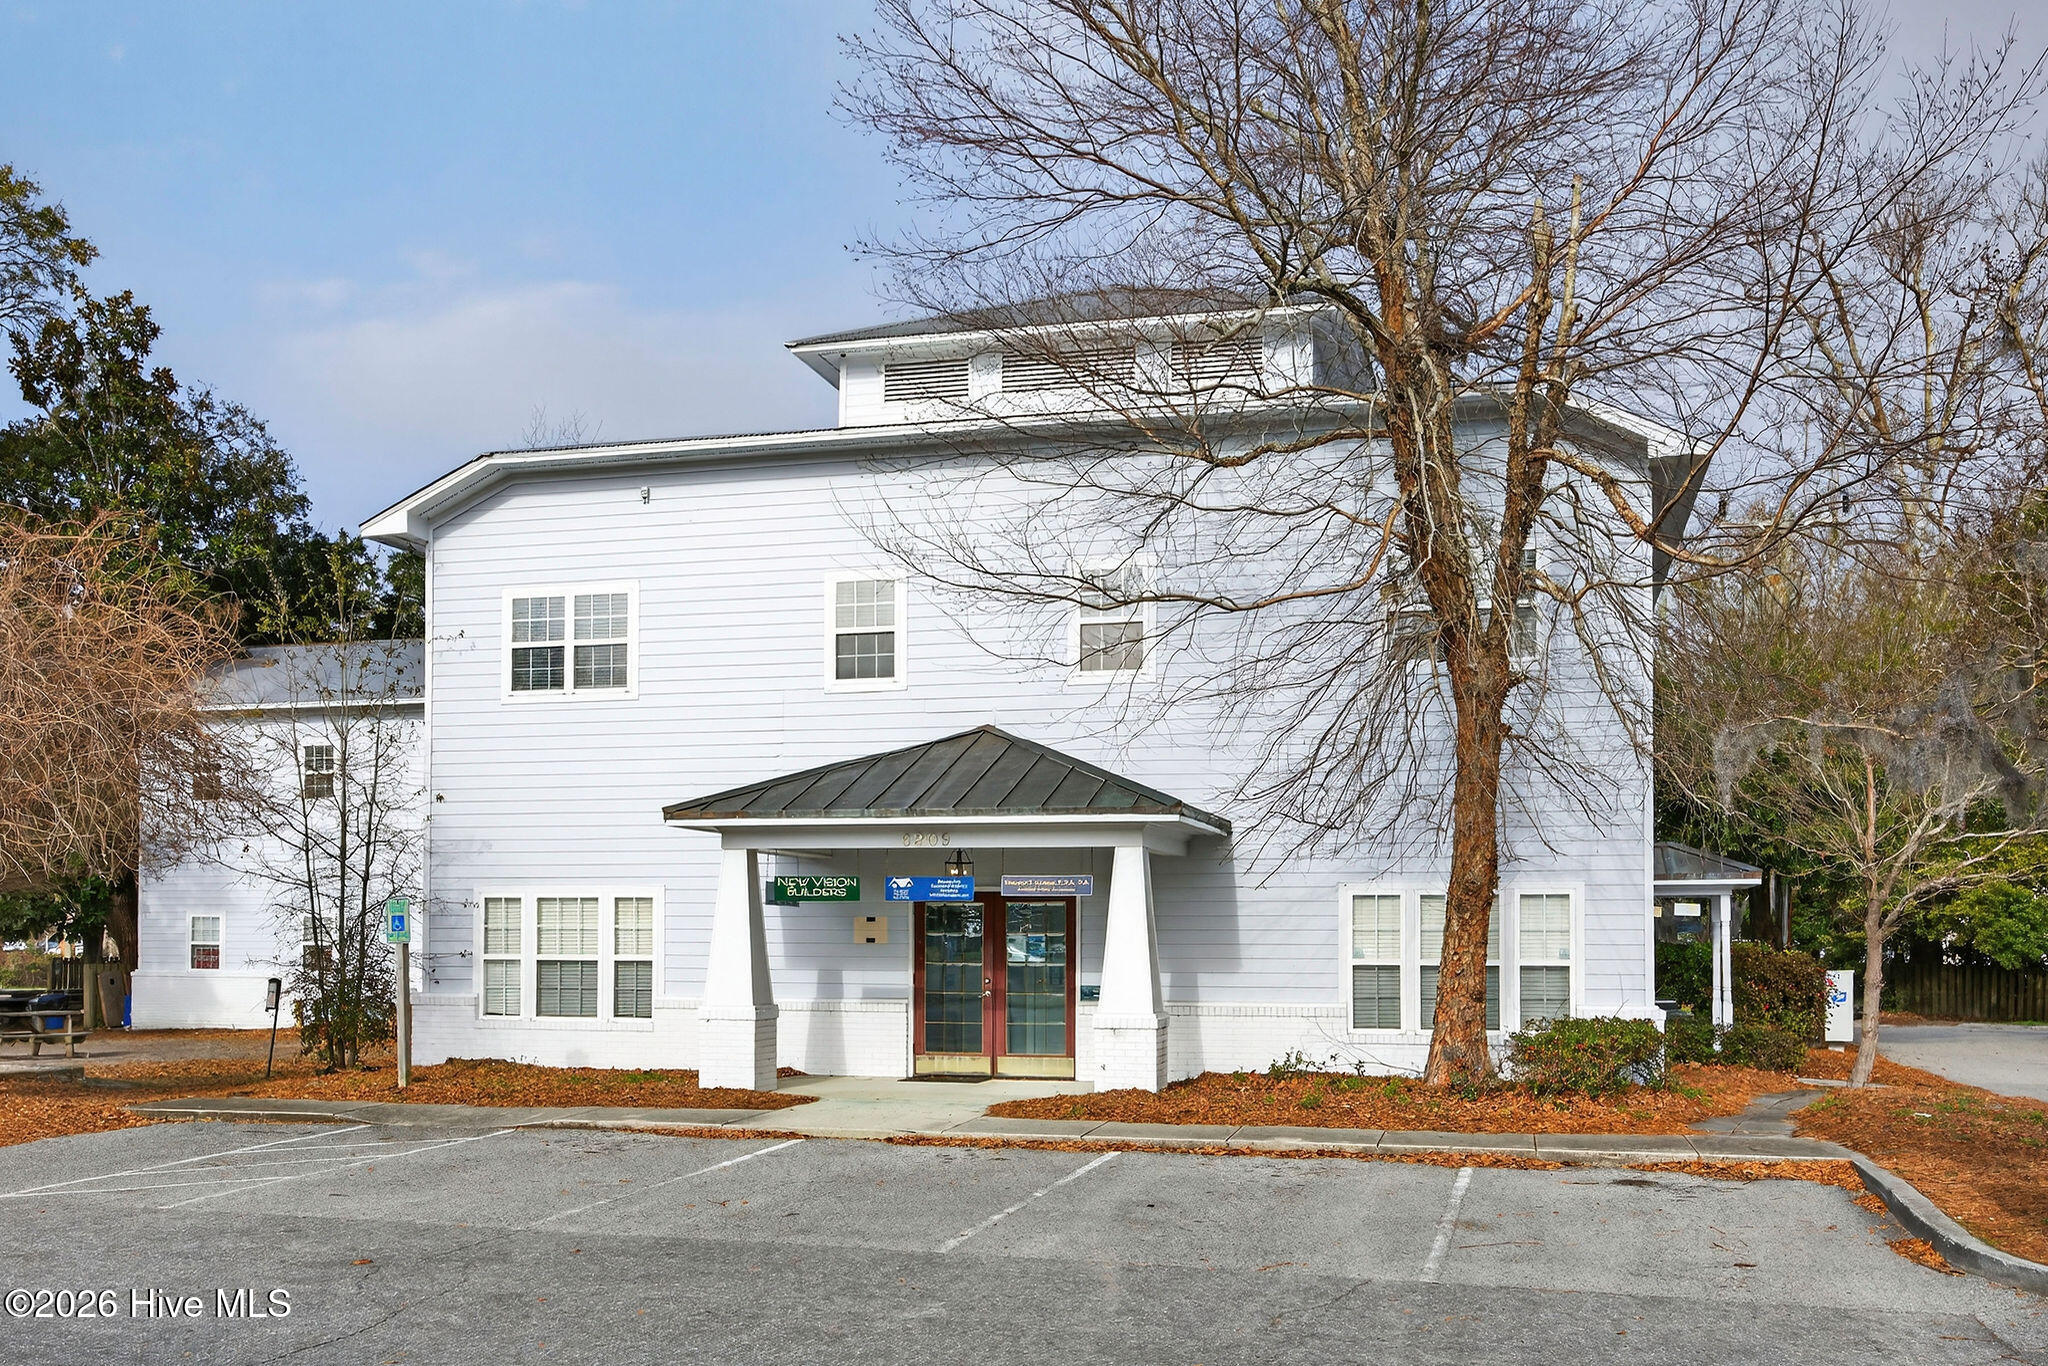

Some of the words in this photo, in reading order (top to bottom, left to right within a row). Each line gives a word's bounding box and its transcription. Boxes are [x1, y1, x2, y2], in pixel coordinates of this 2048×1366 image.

[777, 877, 809, 887] NEW
[811, 876, 856, 887] VISION
[787, 887, 846, 896] BUILDERS
